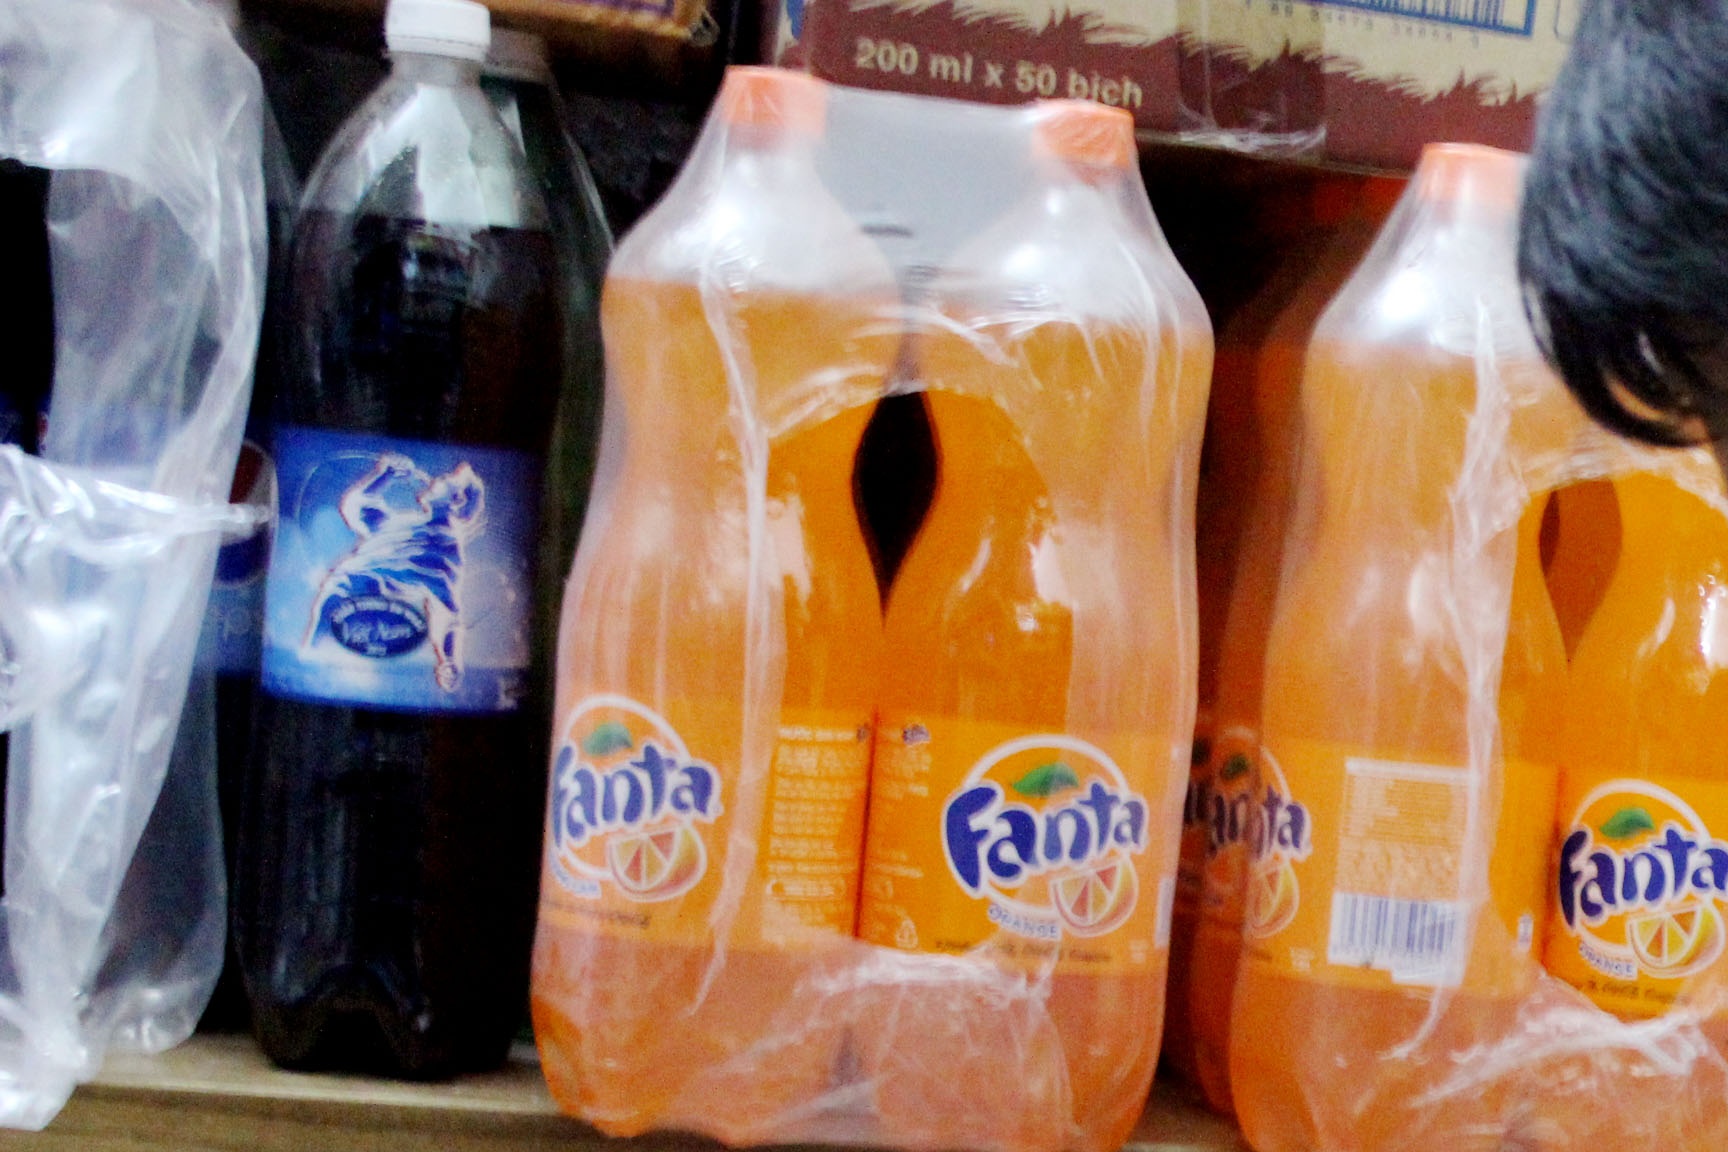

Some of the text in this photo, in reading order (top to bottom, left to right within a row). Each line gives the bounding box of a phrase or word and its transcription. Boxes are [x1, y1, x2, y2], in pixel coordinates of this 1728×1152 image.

[855, 37, 919, 76] 200
[929, 52, 974, 84] ml
[983, 60, 1005, 89] x
[1014, 59, 1058, 96] 50
[944, 782, 1147, 891] Fanta
